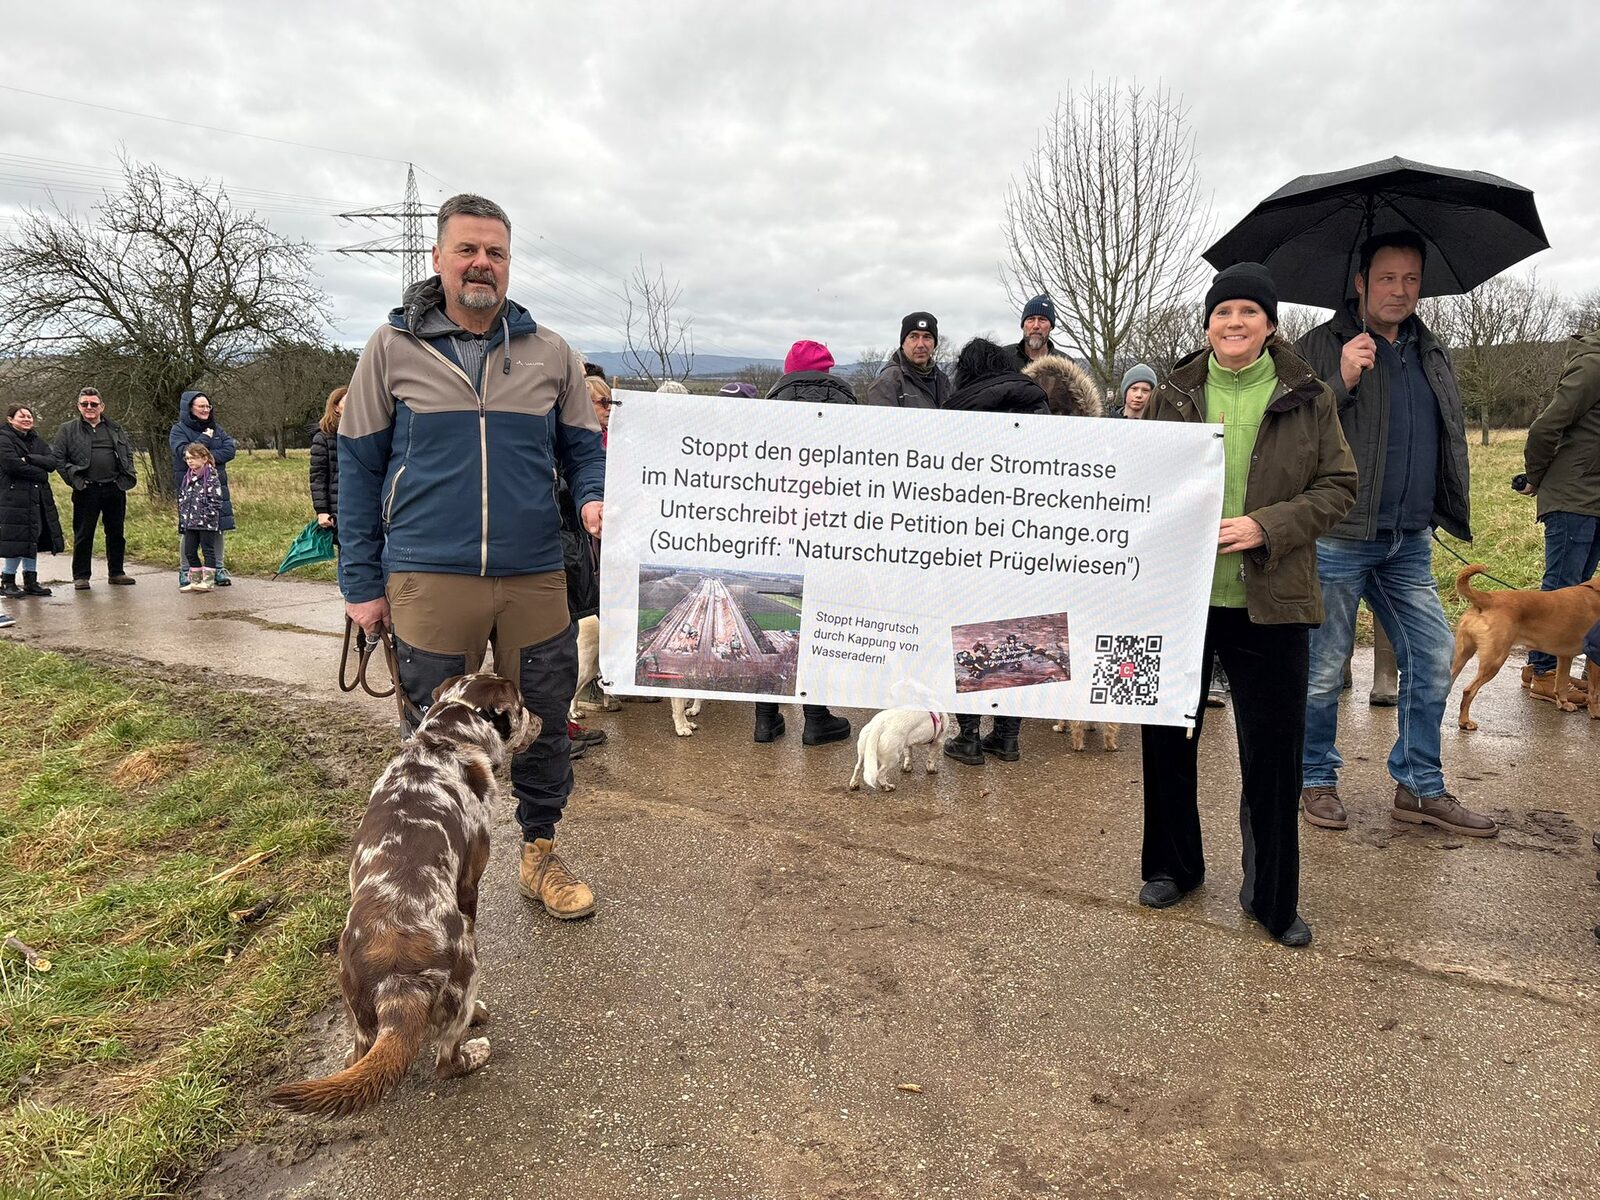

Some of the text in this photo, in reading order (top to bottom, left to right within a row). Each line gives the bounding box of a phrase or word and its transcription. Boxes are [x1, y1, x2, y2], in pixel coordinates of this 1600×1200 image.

[682, 436, 1116, 478] Stoppt den geplanten Bau der Stromtrasse
[643, 466, 1150, 512] im Naturschutzgebiet in Wiesbaden-Breckenheim!
[661, 500, 1128, 548] Unterschreibt jetzt die Petition bei Change.org
[651, 529, 1139, 581] (Suchbegriff: "Naturschutzgebiet Prügelwiesen")
[813, 628, 919, 652] durch Kappung von
[816, 612, 918, 634] Stoppt Hangrutsch
[812, 645, 885, 664] Wasseradern!
